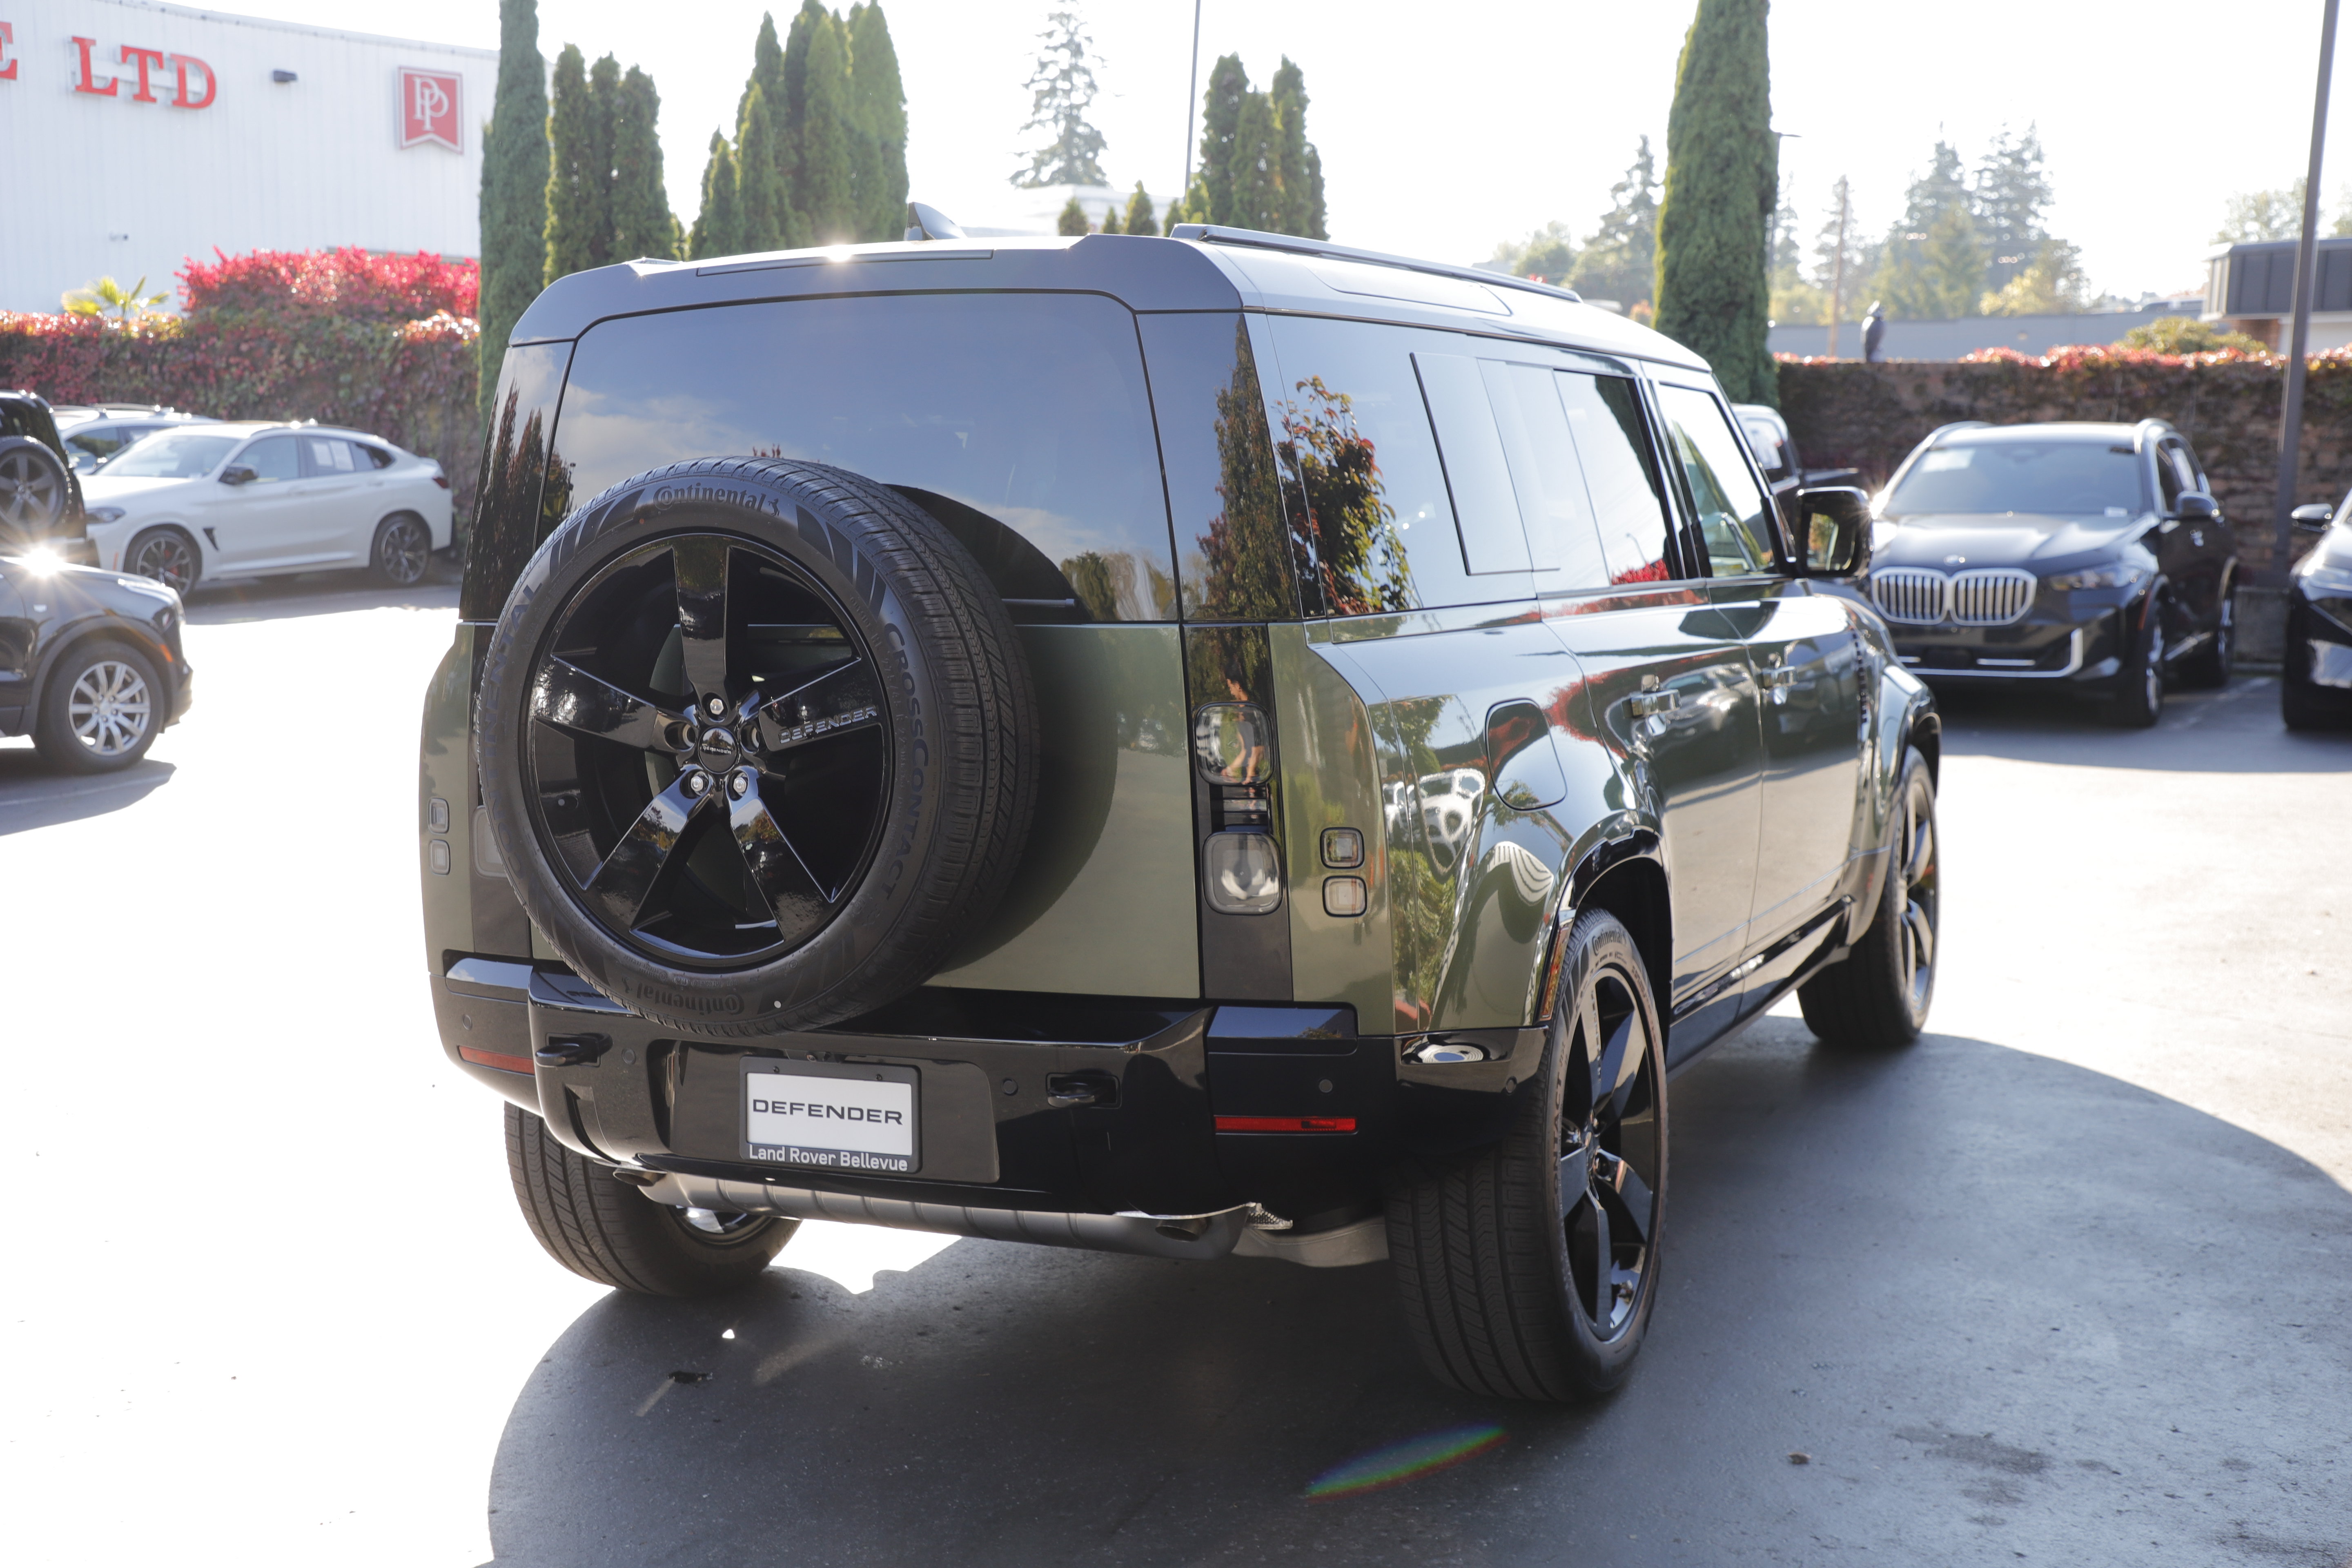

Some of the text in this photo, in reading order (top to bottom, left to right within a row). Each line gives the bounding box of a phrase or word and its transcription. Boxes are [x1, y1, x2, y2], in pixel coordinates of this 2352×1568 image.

[71, 36, 216, 109] LTD
[653, 482, 767, 511] Continental
[780, 705, 879, 744] DEFENDER
[702, 744, 732, 755] DEFENDER
[1591, 927, 1624, 957] Continental
[637, 982, 745, 1016] Continental
[753, 1099, 903, 1125] DEFENDER
[749, 1144, 908, 1172] Land Rover Bellevue
